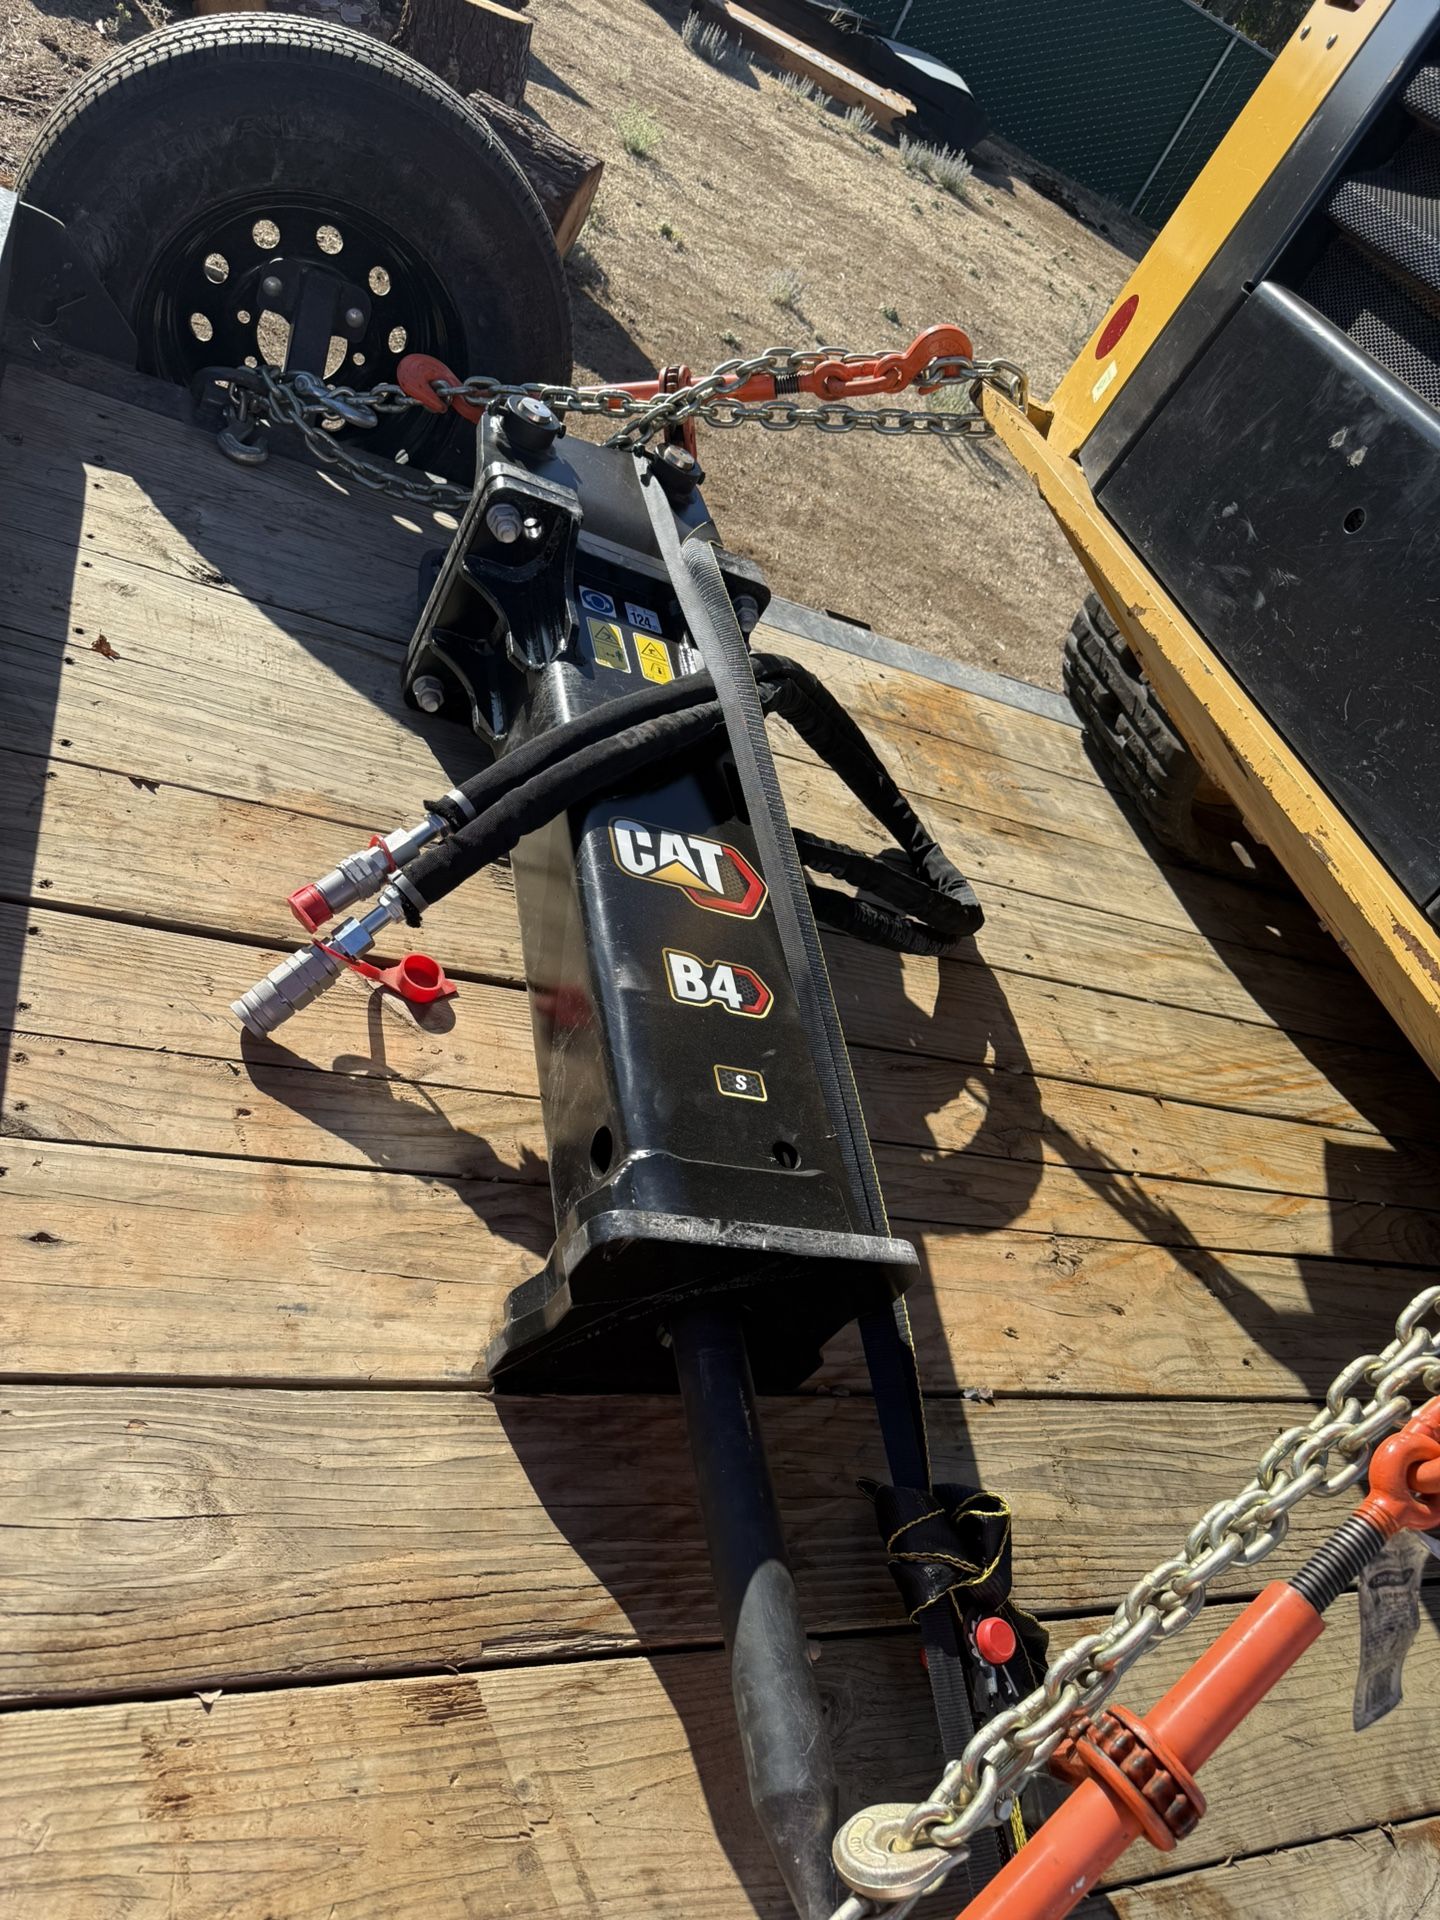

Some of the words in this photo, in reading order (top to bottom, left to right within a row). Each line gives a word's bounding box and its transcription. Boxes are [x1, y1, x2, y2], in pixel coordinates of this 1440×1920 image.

[630, 612, 652, 629] 124
[614, 819, 725, 895] CAT
[668, 952, 743, 1010] B4
[735, 1074, 748, 1091] S
